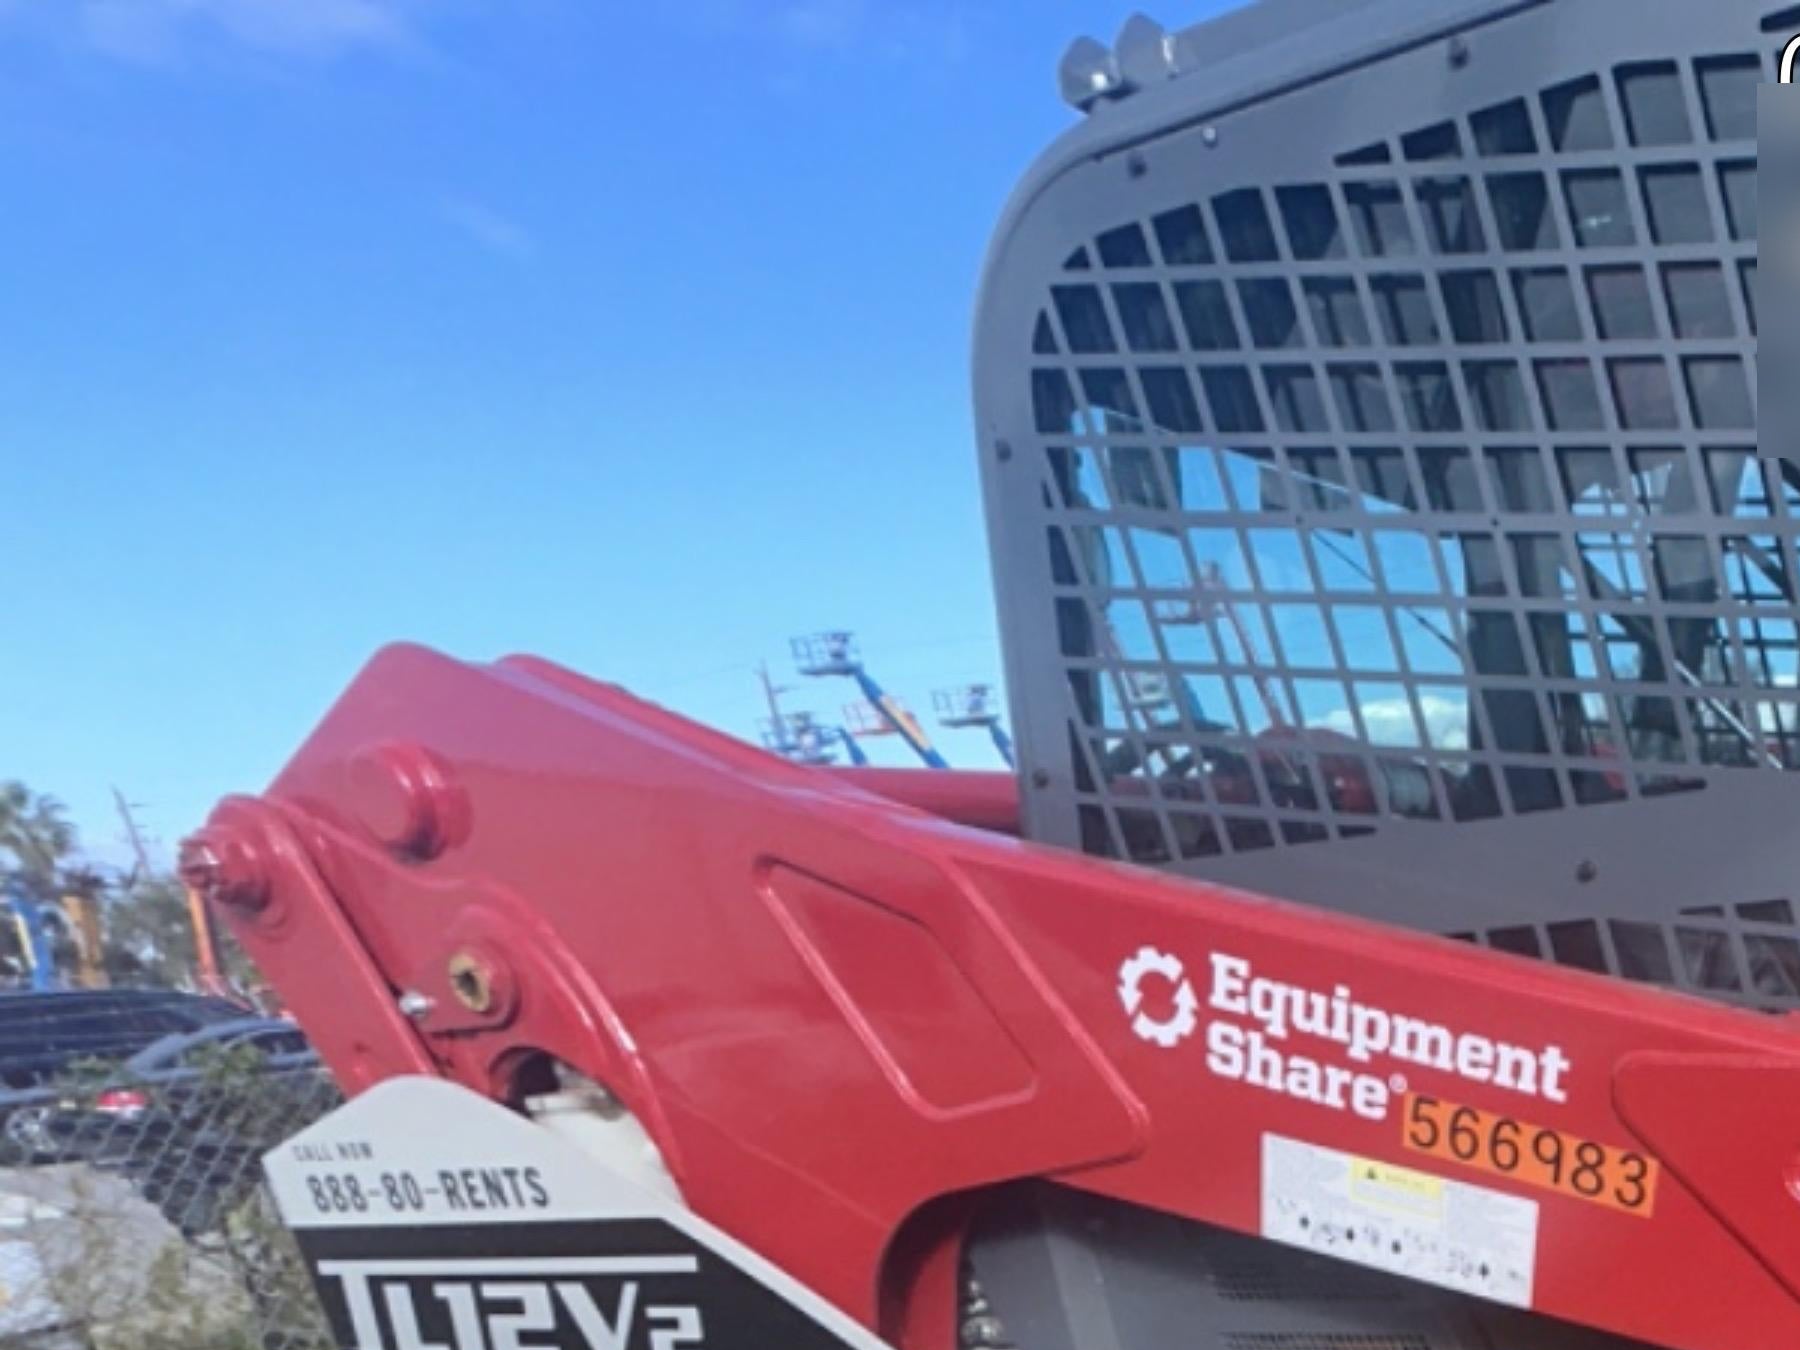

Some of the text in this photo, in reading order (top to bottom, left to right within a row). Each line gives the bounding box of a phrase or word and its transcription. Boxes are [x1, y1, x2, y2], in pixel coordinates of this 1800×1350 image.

[1209, 952, 1571, 1102] Equipment
[306, 1166, 549, 1213] 888-80-RENTS
[1407, 1094, 1650, 1209] 566983
